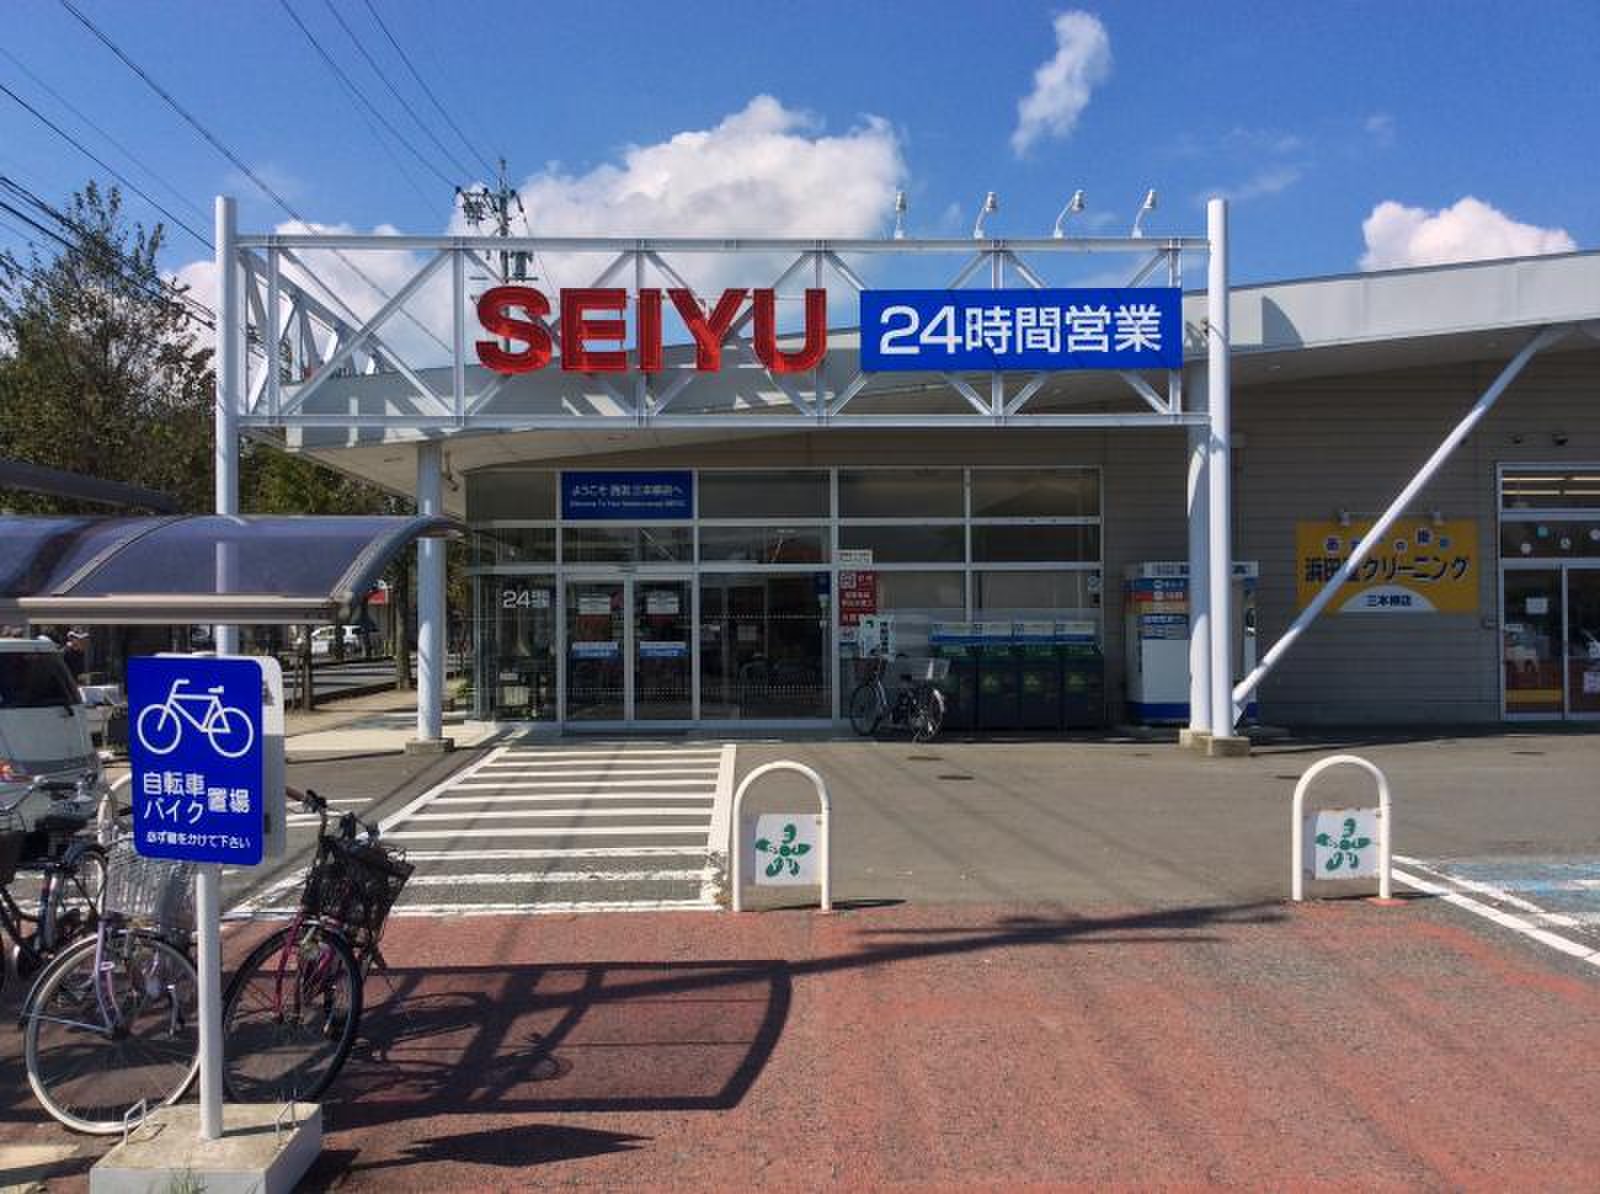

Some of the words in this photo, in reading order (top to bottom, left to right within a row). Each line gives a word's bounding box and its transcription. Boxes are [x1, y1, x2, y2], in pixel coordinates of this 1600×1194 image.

[475, 285, 827, 375] SEIYU
[879, 304, 1162, 355] 24時間営業
[143, 770, 206, 797] 自転車
[143, 797, 203, 824] バイク
[207, 787, 250, 813] 置場
